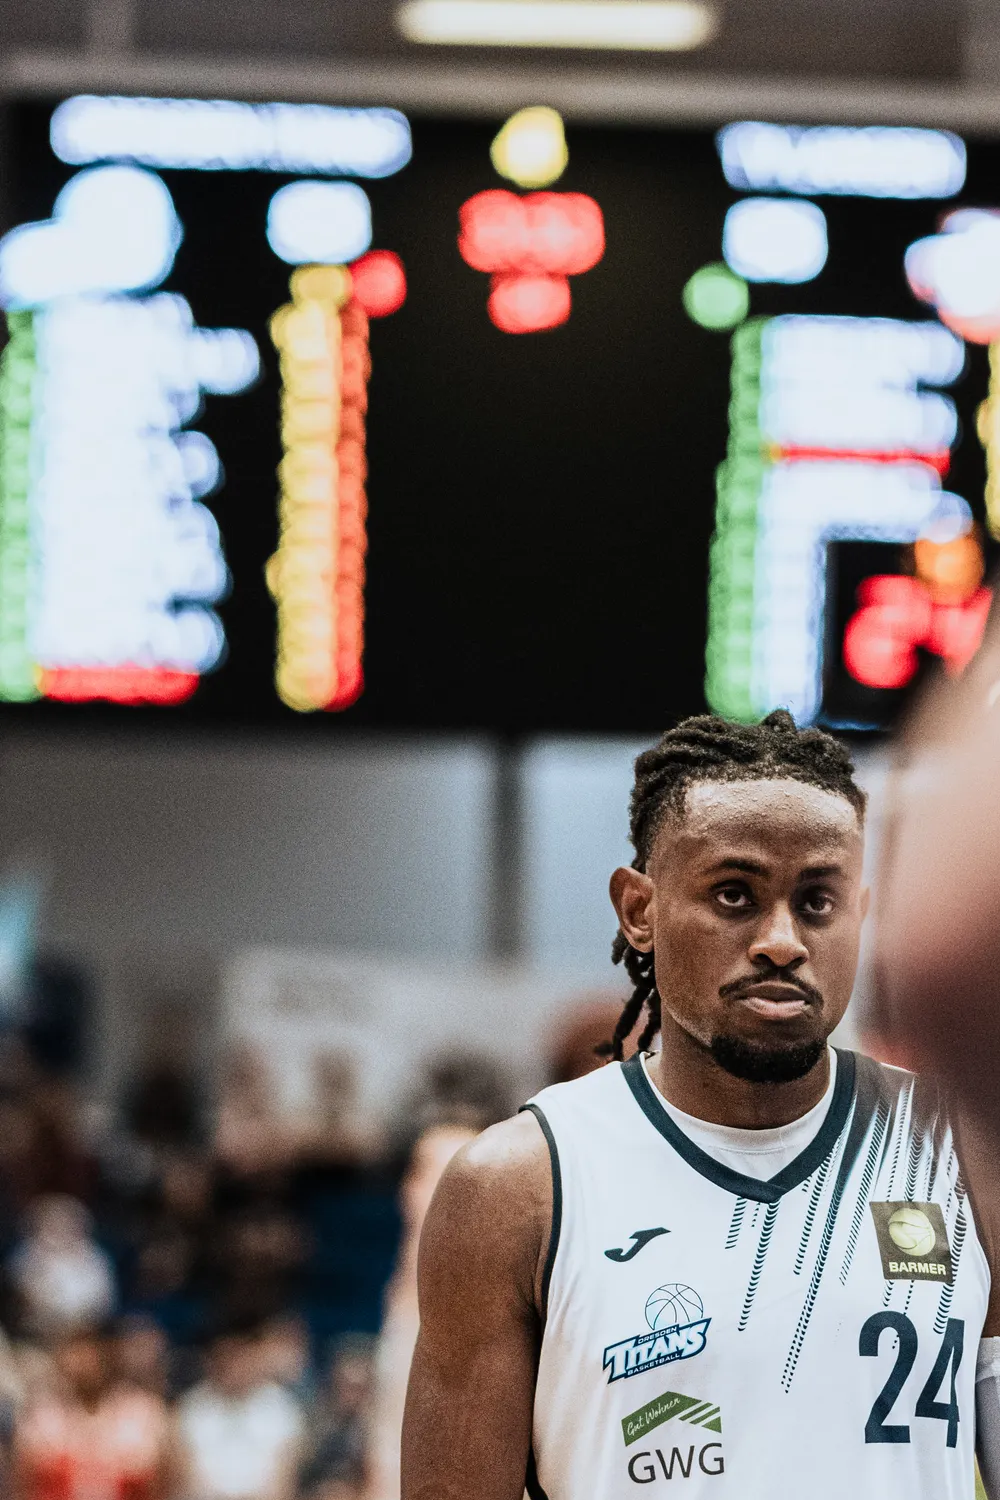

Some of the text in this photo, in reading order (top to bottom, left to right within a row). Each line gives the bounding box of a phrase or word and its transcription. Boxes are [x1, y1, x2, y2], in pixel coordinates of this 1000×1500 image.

[888, 1260, 947, 1277] BARMER
[604, 1320, 709, 1381] TITANS
[637, 1326, 678, 1345] DRESDEN
[627, 1353, 681, 1377] BASKETBALL
[858, 1310, 966, 1449] 24
[627, 1397, 681, 1437] Gut Wohnen
[627, 1442, 725, 1485] GWG
